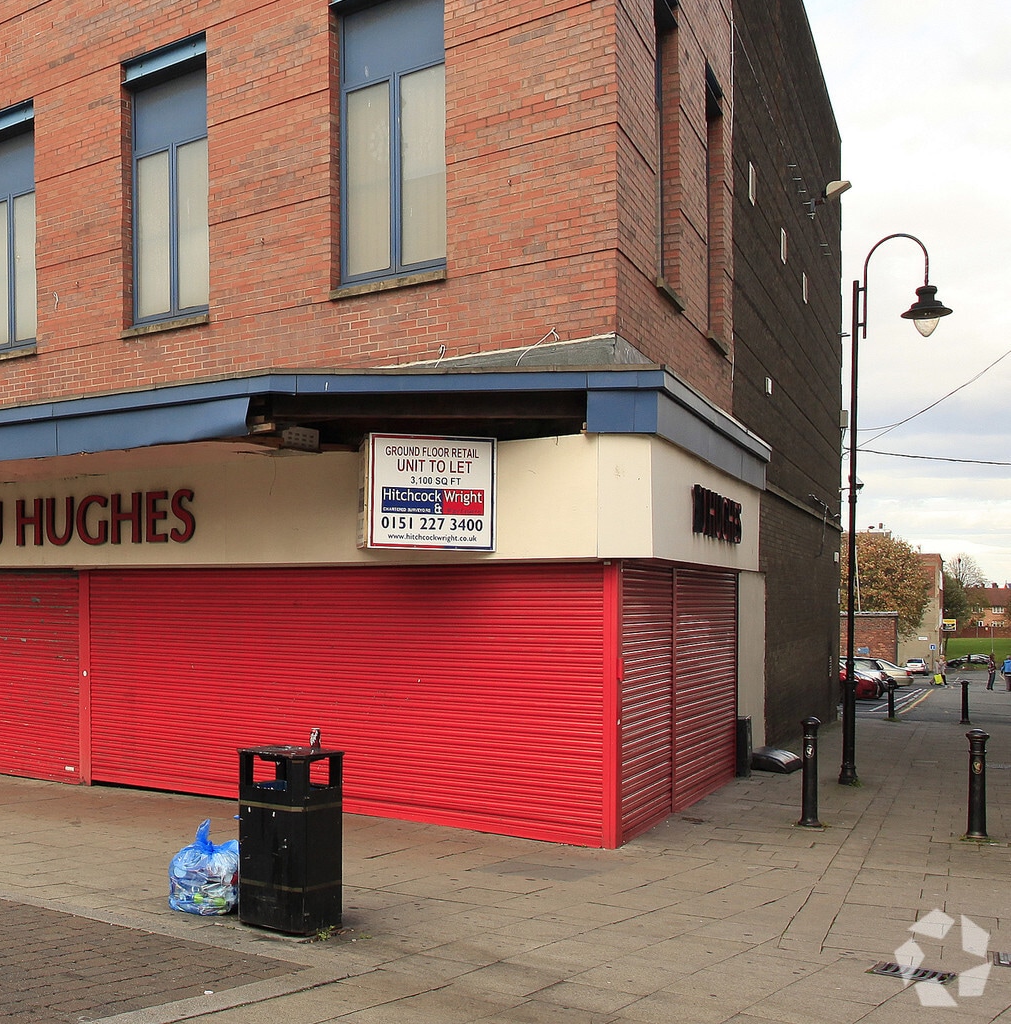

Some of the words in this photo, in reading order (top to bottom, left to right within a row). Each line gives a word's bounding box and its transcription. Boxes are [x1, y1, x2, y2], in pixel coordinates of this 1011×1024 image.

[385, 446, 420, 457] GROUND
[422, 447, 450, 458] FLOOR
[452, 448, 479, 459] RETAIL
[397, 459, 426, 472] UNIT
[428, 460, 446, 473] TO
[449, 461, 473, 474] LET
[410, 476, 433, 486] 3,100
[435, 477, 448, 486] SQ
[450, 478, 461, 486] FT
[382, 488, 442, 503] Hitchcock
[443, 490, 483, 505] Wright
[434, 503, 442, 514] &
[15, 488, 196, 546] HUGHES
[381, 516, 413, 529] 0151
[420, 517, 445, 530] 227
[450, 518, 483, 532] 3400
[388, 533, 477, 543] www.hitchcockwright.co.uk
